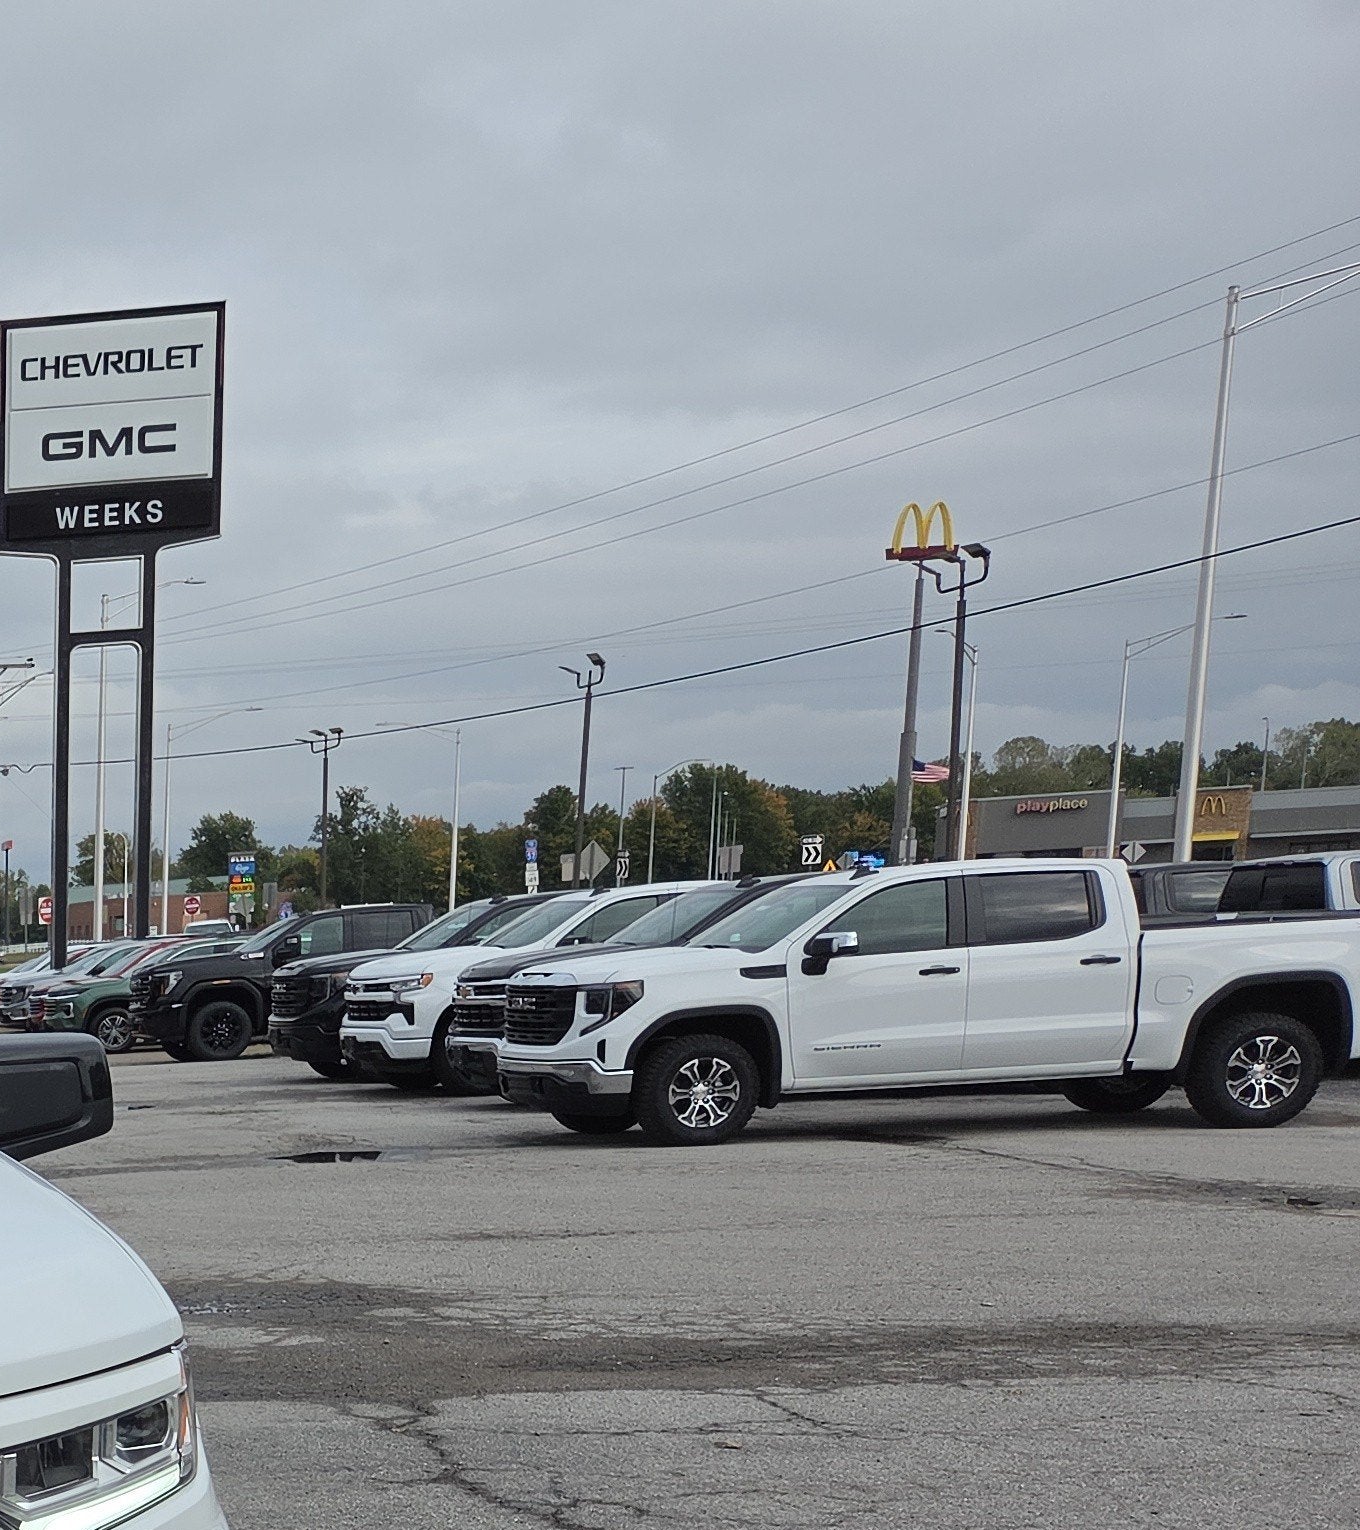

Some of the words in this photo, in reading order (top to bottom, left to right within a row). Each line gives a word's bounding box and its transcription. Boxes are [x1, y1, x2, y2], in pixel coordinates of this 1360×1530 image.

[20, 343, 204, 382] CHEVROLET
[41, 422, 177, 462] GMC
[55, 499, 163, 529] WEEKS
[1016, 798, 1088, 815] playplace
